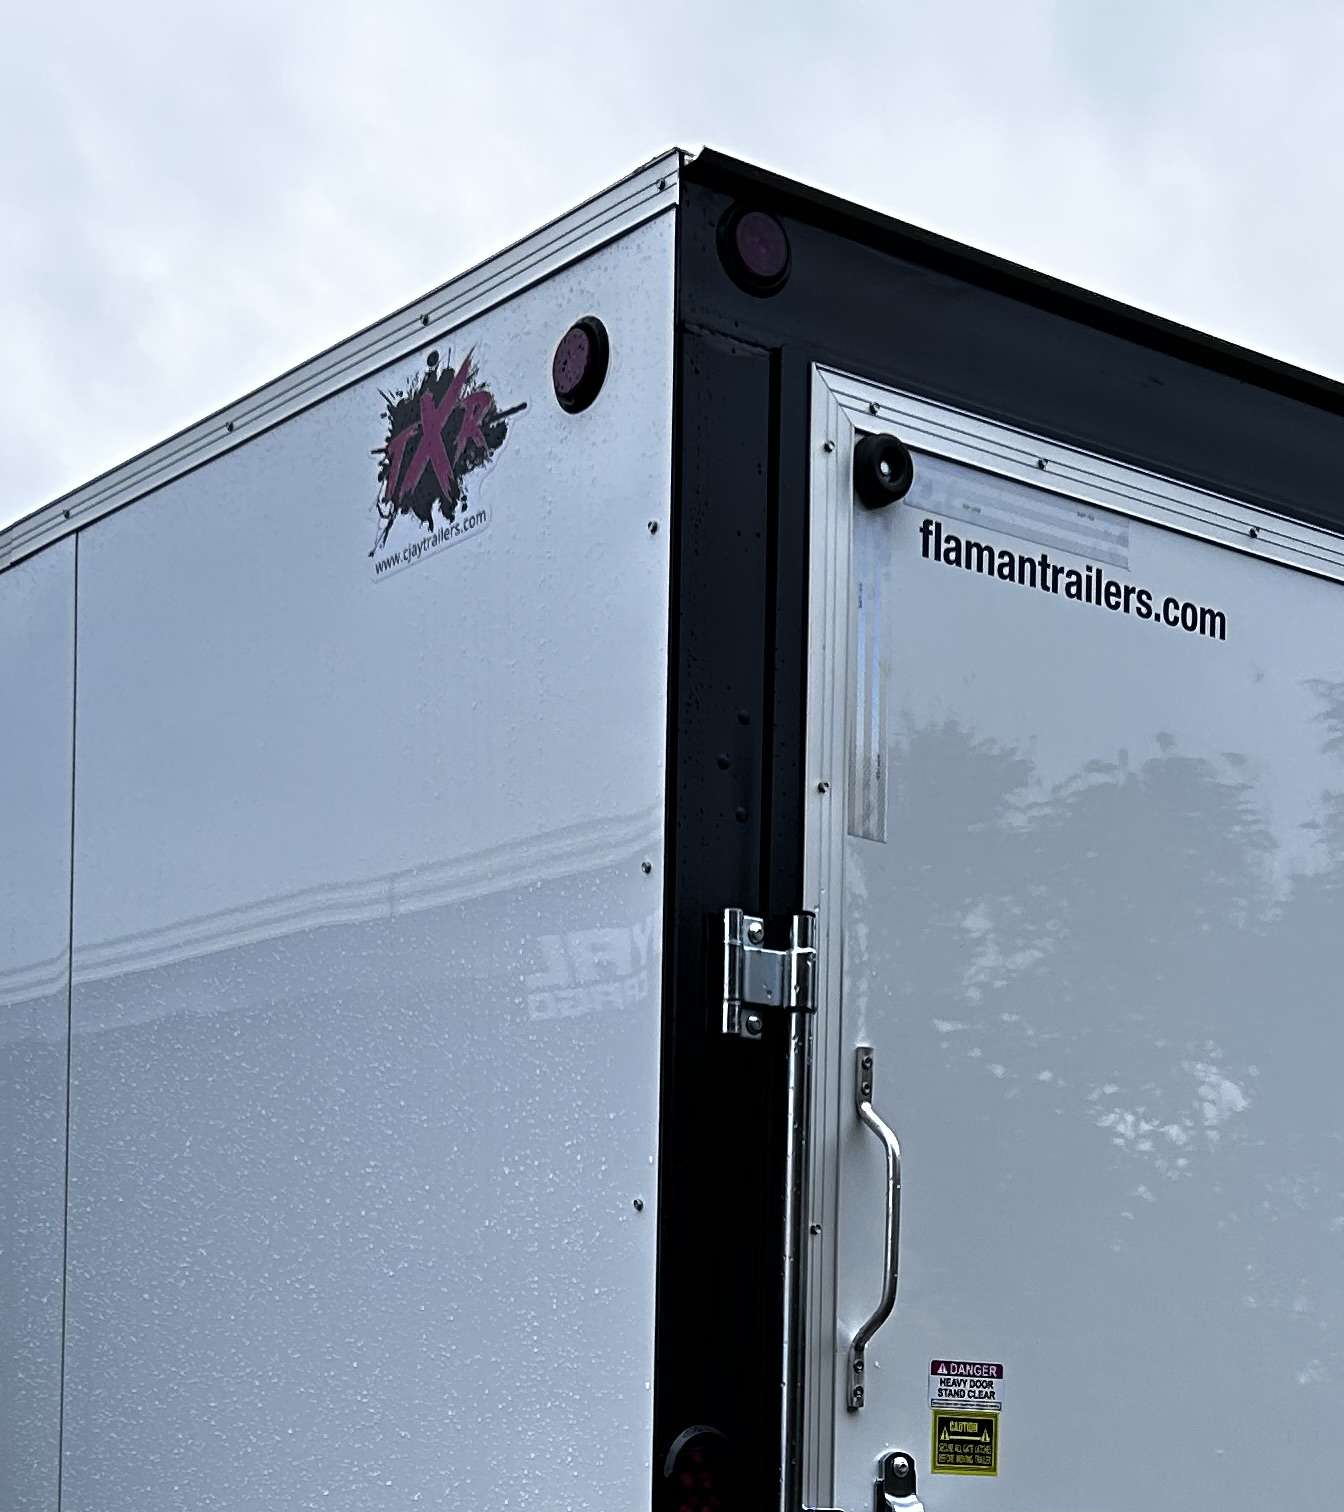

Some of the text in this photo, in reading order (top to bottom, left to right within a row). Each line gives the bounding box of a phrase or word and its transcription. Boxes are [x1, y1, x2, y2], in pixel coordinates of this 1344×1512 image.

[385, 346, 493, 503] TXR
[374, 508, 488, 575] www.cjaytrailers.com
[919, 518, 1227, 641] flamantrailers.com
[939, 1378, 994, 1389] HEAVY DOOR
[950, 1363, 998, 1377] DANGER
[938, 1388, 996, 1400] STAND CLEAR
